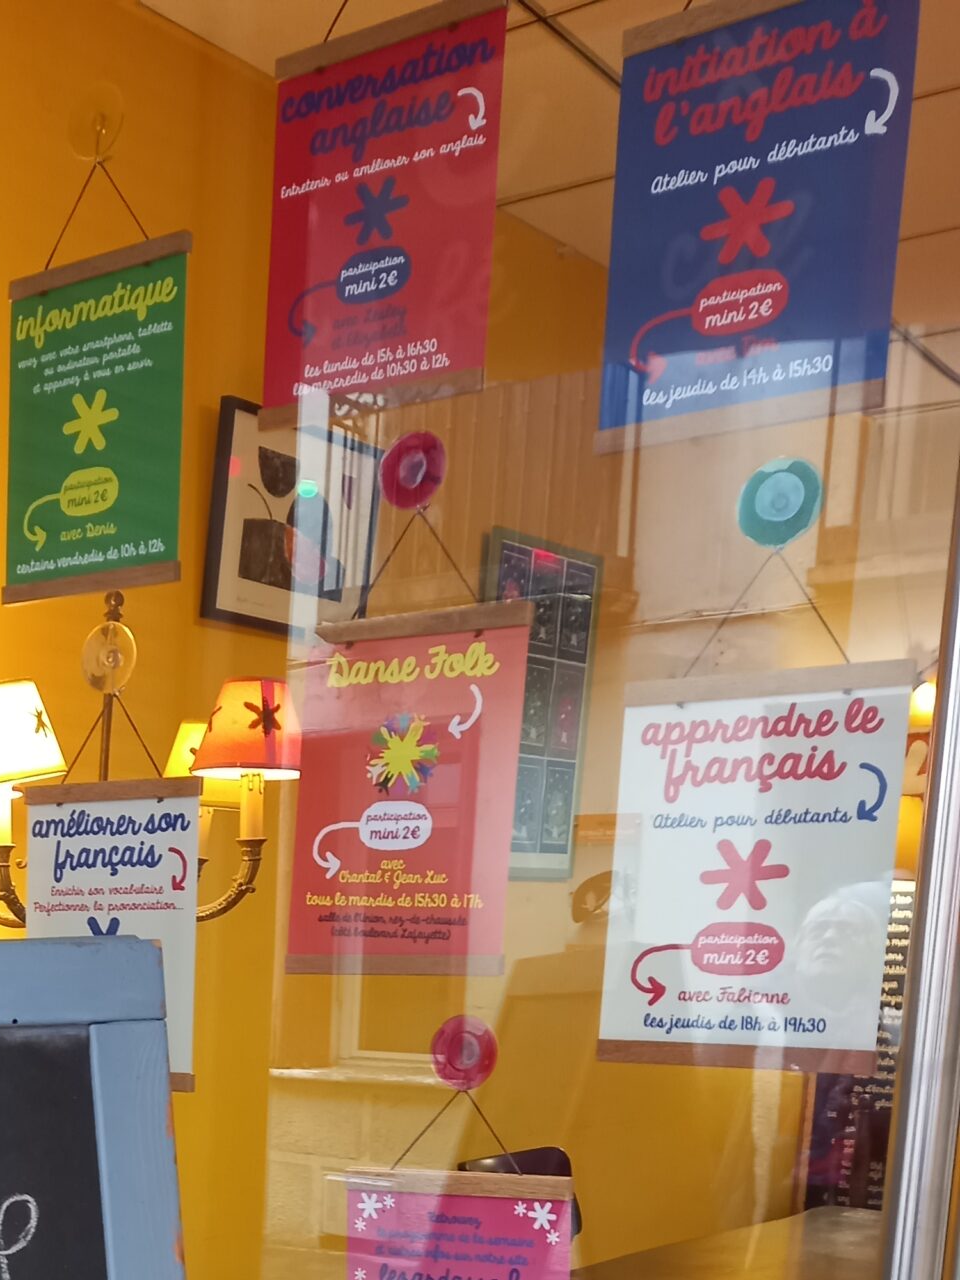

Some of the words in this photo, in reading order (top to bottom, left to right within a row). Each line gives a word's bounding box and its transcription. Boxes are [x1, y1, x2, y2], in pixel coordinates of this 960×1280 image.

[644, 20, 839, 103] initiation
[849, 1, 887, 39] à
[281, 36, 495, 124] conversation
[654, 61, 865, 147] l'anglais
[309, 89, 455, 163] anglaise
[281, 172, 331, 199] Entretenir
[335, 170, 349, 181] ou
[353, 155, 410, 178] améliorer
[413, 147, 435, 162] son
[440, 134, 486, 157] anglais
[714, 157, 759, 186] pour
[767, 124, 860, 162] débutants
[340, 255, 405, 281] participation
[345, 278, 376, 296] mini
[379, 270, 398, 288] 2€
[699, 280, 783, 310] participation
[16, 276, 177, 349] informatique
[705, 307, 745, 329] mini
[748, 300, 773, 319] 2€
[138, 321, 173, 337] tablette
[304, 364, 321, 378] les
[323, 359, 359, 375] lundis
[362, 352, 375, 366] de
[377, 347, 393, 363] 15h
[396, 345, 405, 358] à
[407, 338, 438, 357] 16h30
[312, 371, 369, 392] mercredis
[371, 366, 384, 380] de
[386, 360, 417, 377] 10h30
[420, 358, 430, 371] à
[432, 353, 450, 368] 12h
[643, 388, 668, 406] les
[666, 379, 717, 408] jeudis
[720, 373, 740, 390] de
[743, 367, 768, 387] 14h
[773, 364, 786, 381] à
[789, 354, 833, 378] 15h30
[67, 496, 91, 509] mini
[94, 489, 108, 503] 2€
[60, 528, 83, 541] avec
[86, 523, 117, 538] Denis
[16, 558, 56, 574] certains
[57, 550, 105, 568] vendredis
[107, 546, 119, 560] de
[120, 542, 137, 557] 10h
[139, 541, 147, 554] à
[148, 538, 165, 553] 12h
[327, 651, 420, 688] Danse
[425, 641, 500, 681] Folk
[641, 702, 838, 760] apprendre
[843, 697, 885, 734] le
[663, 746, 847, 804] français
[31, 808, 141, 839] améliorer
[142, 811, 190, 834] son
[365, 811, 428, 827] participation
[370, 827, 402, 841] mini
[402, 826, 421, 840] 2€
[713, 814, 757, 833] pour
[764, 806, 853, 825] débutants
[53, 840, 164, 884] français
[380, 859, 406, 870] avec
[50, 886, 86, 897] Enrichir
[87, 887, 105, 896] son
[108, 884, 165, 896] vocabulaire
[339, 870, 383, 884] Chantal
[393, 870, 422, 889] Jean
[33, 901, 90, 915] Perfectionner
[92, 901, 105, 912] la
[306, 892, 333, 906] tous
[335, 892, 347, 906] le
[348, 894, 395, 908] mardis
[397, 894, 412, 907] de
[414, 893, 447, 908] 15h30
[450, 895, 461, 907] à
[463, 894, 484, 909] 17h
[698, 933, 779, 950] participation
[703, 948, 743, 966] mini
[744, 948, 770, 966] 2€
[677, 989, 712, 1002] avec
[716, 985, 791, 1006] Fabienne
[643, 1012, 667, 1029] les
[664, 1012, 716, 1034] jeudis
[718, 1015, 739, 1032] de
[740, 1016, 763, 1032] 18h
[767, 1016, 781, 1032] à
[783, 1016, 827, 1033] 19h30
